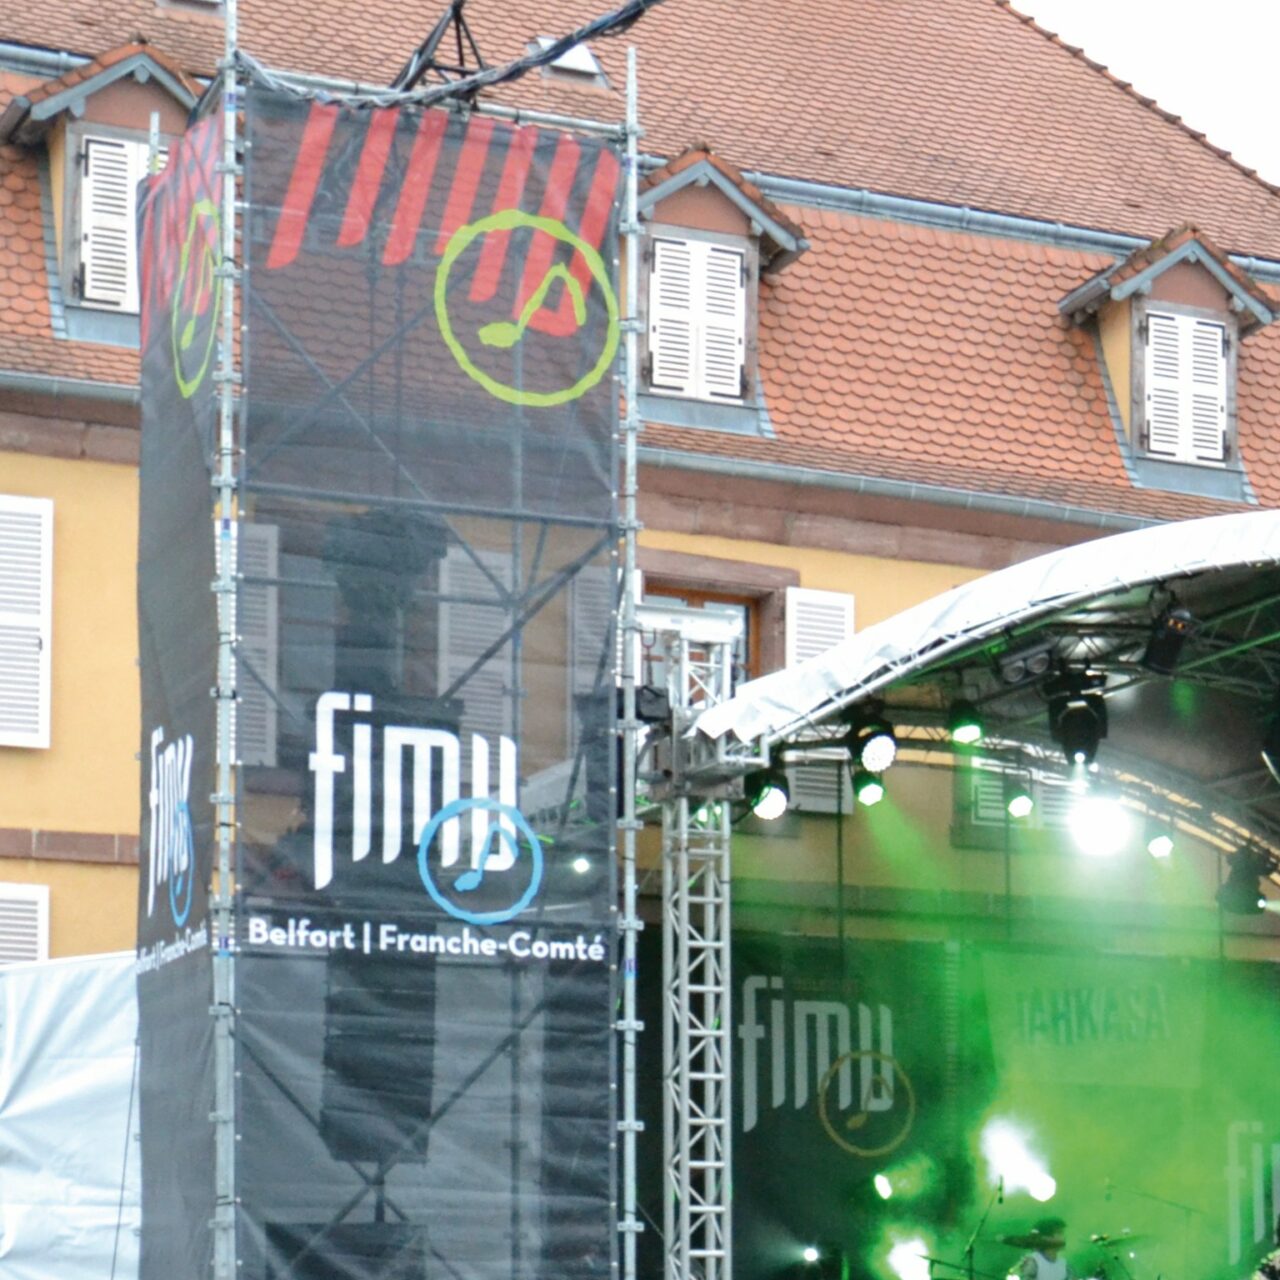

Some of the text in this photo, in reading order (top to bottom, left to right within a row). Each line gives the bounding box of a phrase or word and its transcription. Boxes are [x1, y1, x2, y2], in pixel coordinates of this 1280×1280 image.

[308, 691, 518, 891] fimu
[248, 917, 355, 949] Belfort
[379, 924, 605, 961] Franche-Comté
